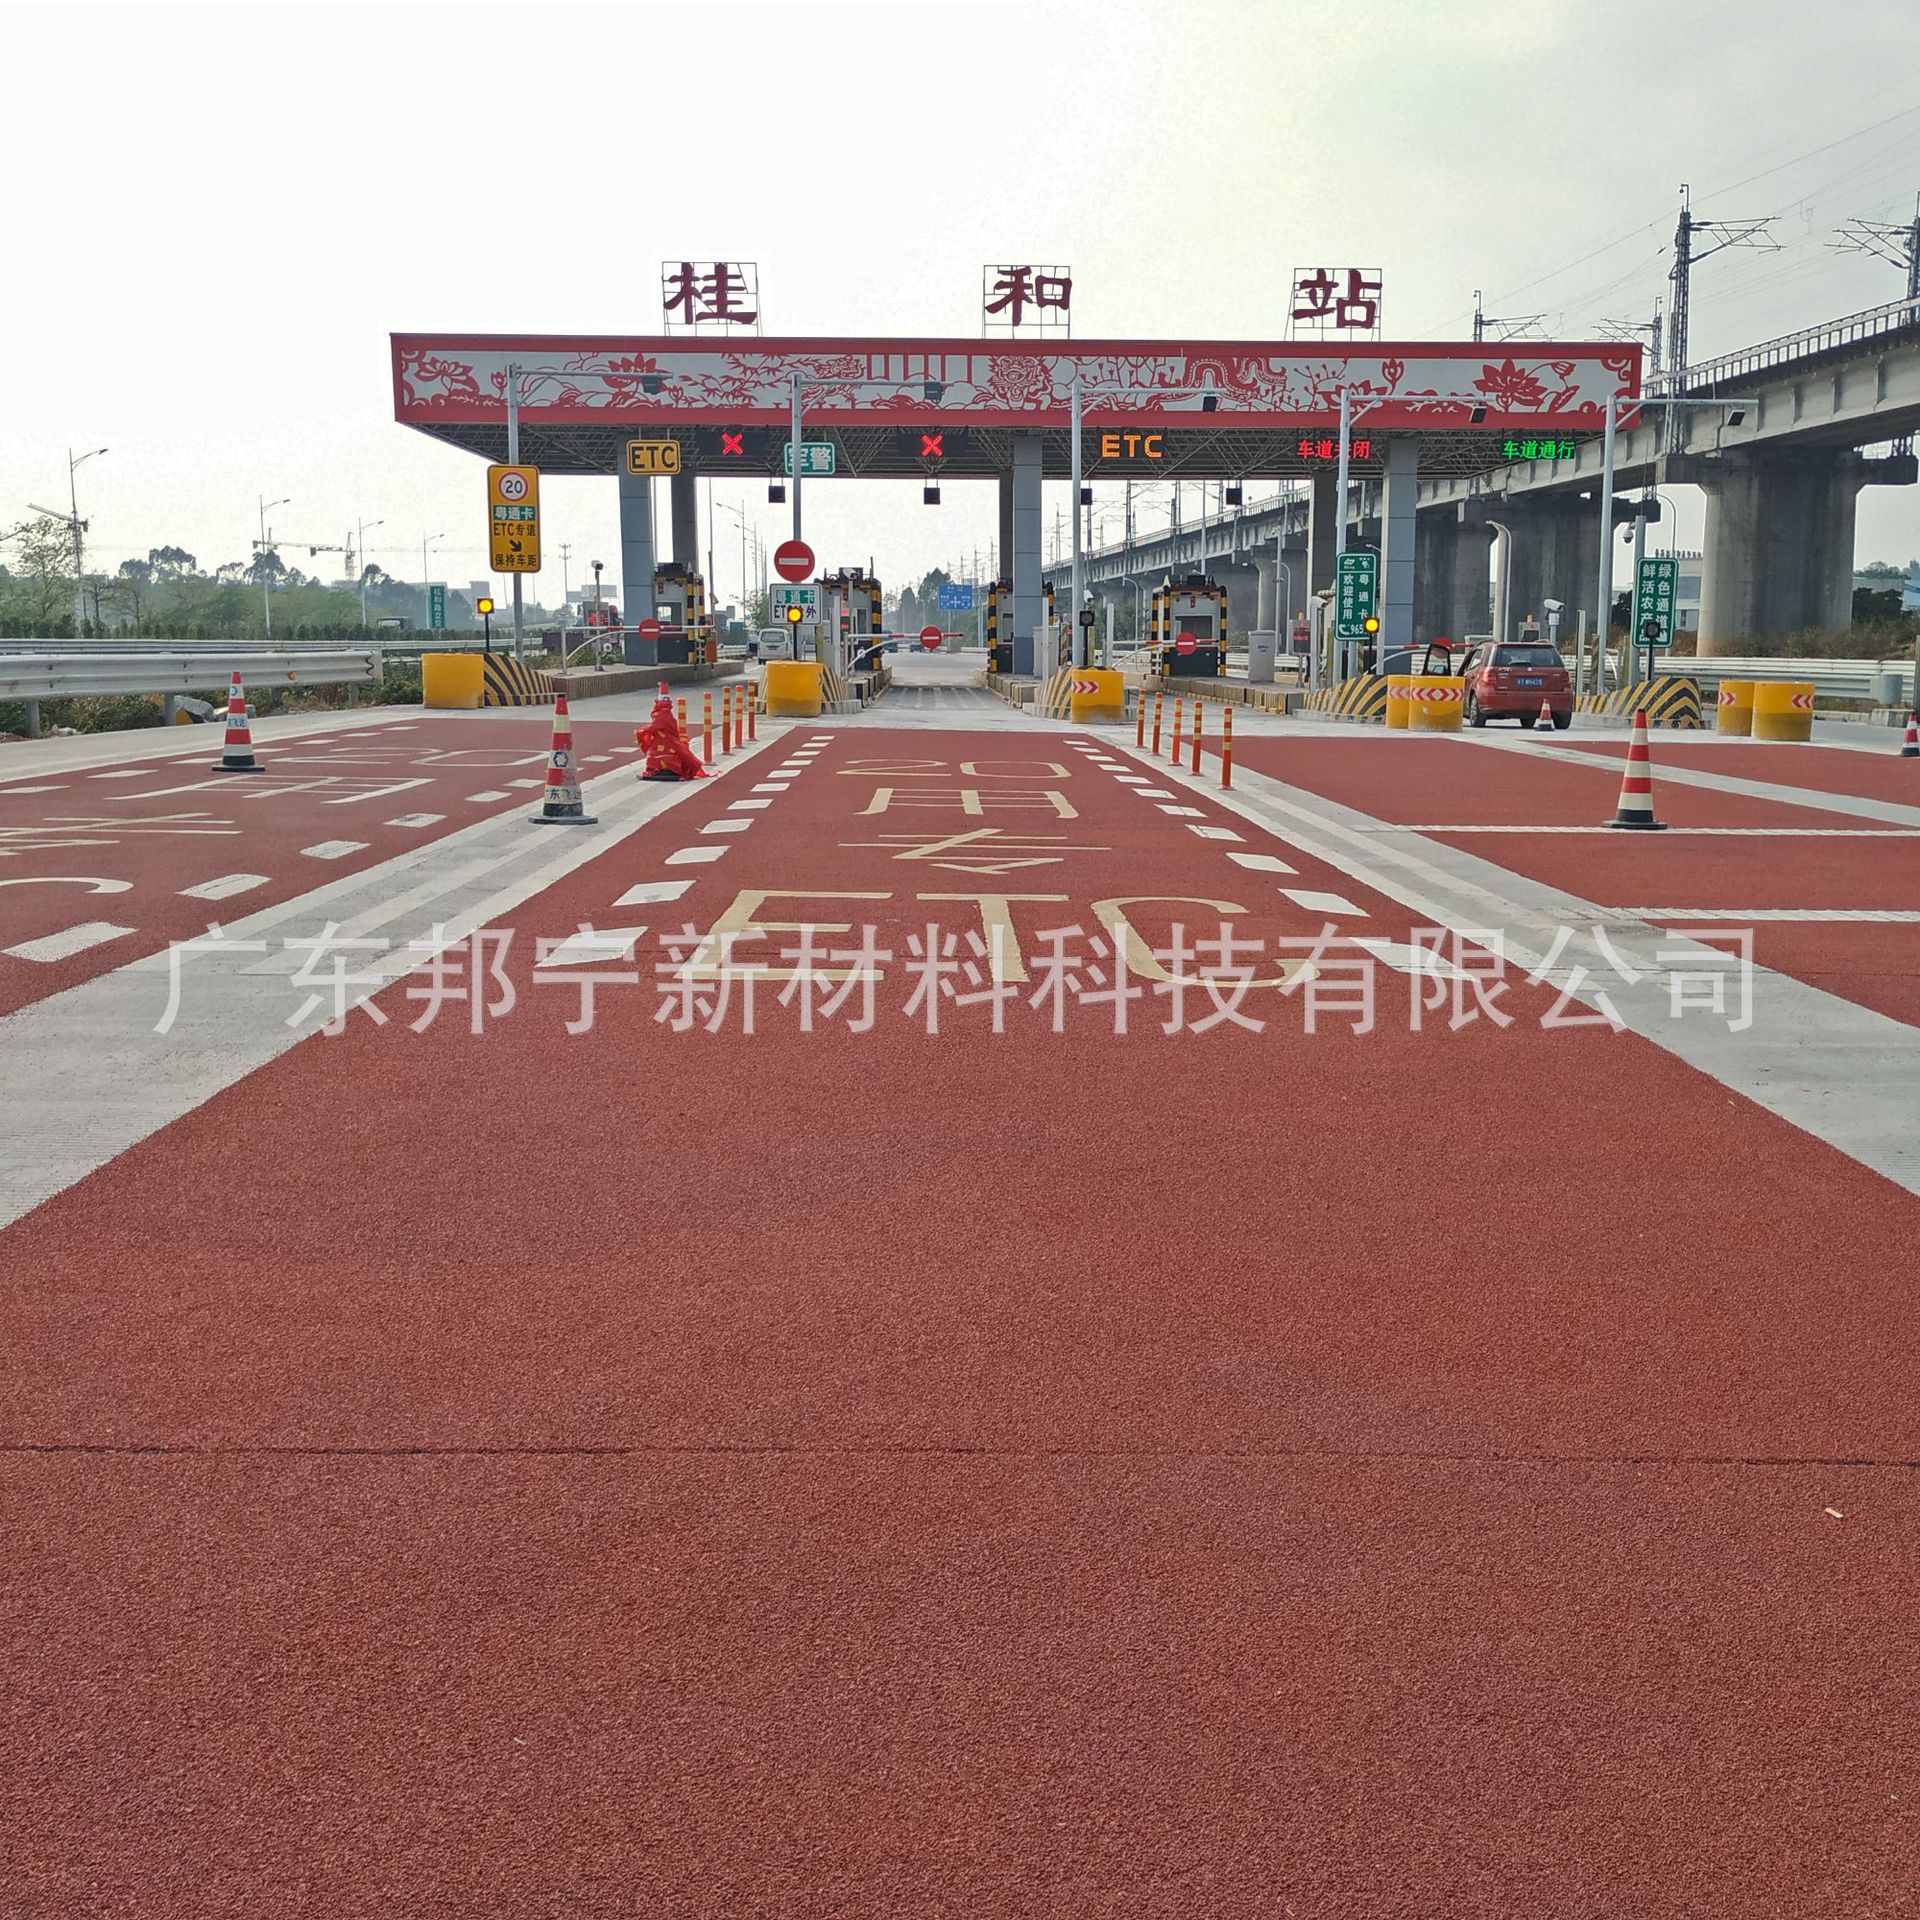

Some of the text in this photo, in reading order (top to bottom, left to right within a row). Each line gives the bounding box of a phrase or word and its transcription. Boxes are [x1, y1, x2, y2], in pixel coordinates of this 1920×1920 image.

[662, 262, 1382, 328] 桂和站
[1102, 434, 1162, 457] ETC
[1502, 440, 1575, 460] 车道通行
[631, 446, 675, 468] ETC
[505, 480, 522, 493] 20
[495, 506, 534, 520] 粤通卡
[493, 523, 536, 536] ETC专道
[495, 554, 536, 566] 保持车距
[1342, 574, 1354, 620] 欢迎使用
[1358, 574, 1370, 619] 粤通卡
[1656, 563, 1672, 629] 绿色通道
[266, 747, 549, 767] 20
[836, 759, 1072, 778] 20
[852, 787, 1080, 819] 用
[673, 889, 1321, 988] ETC
